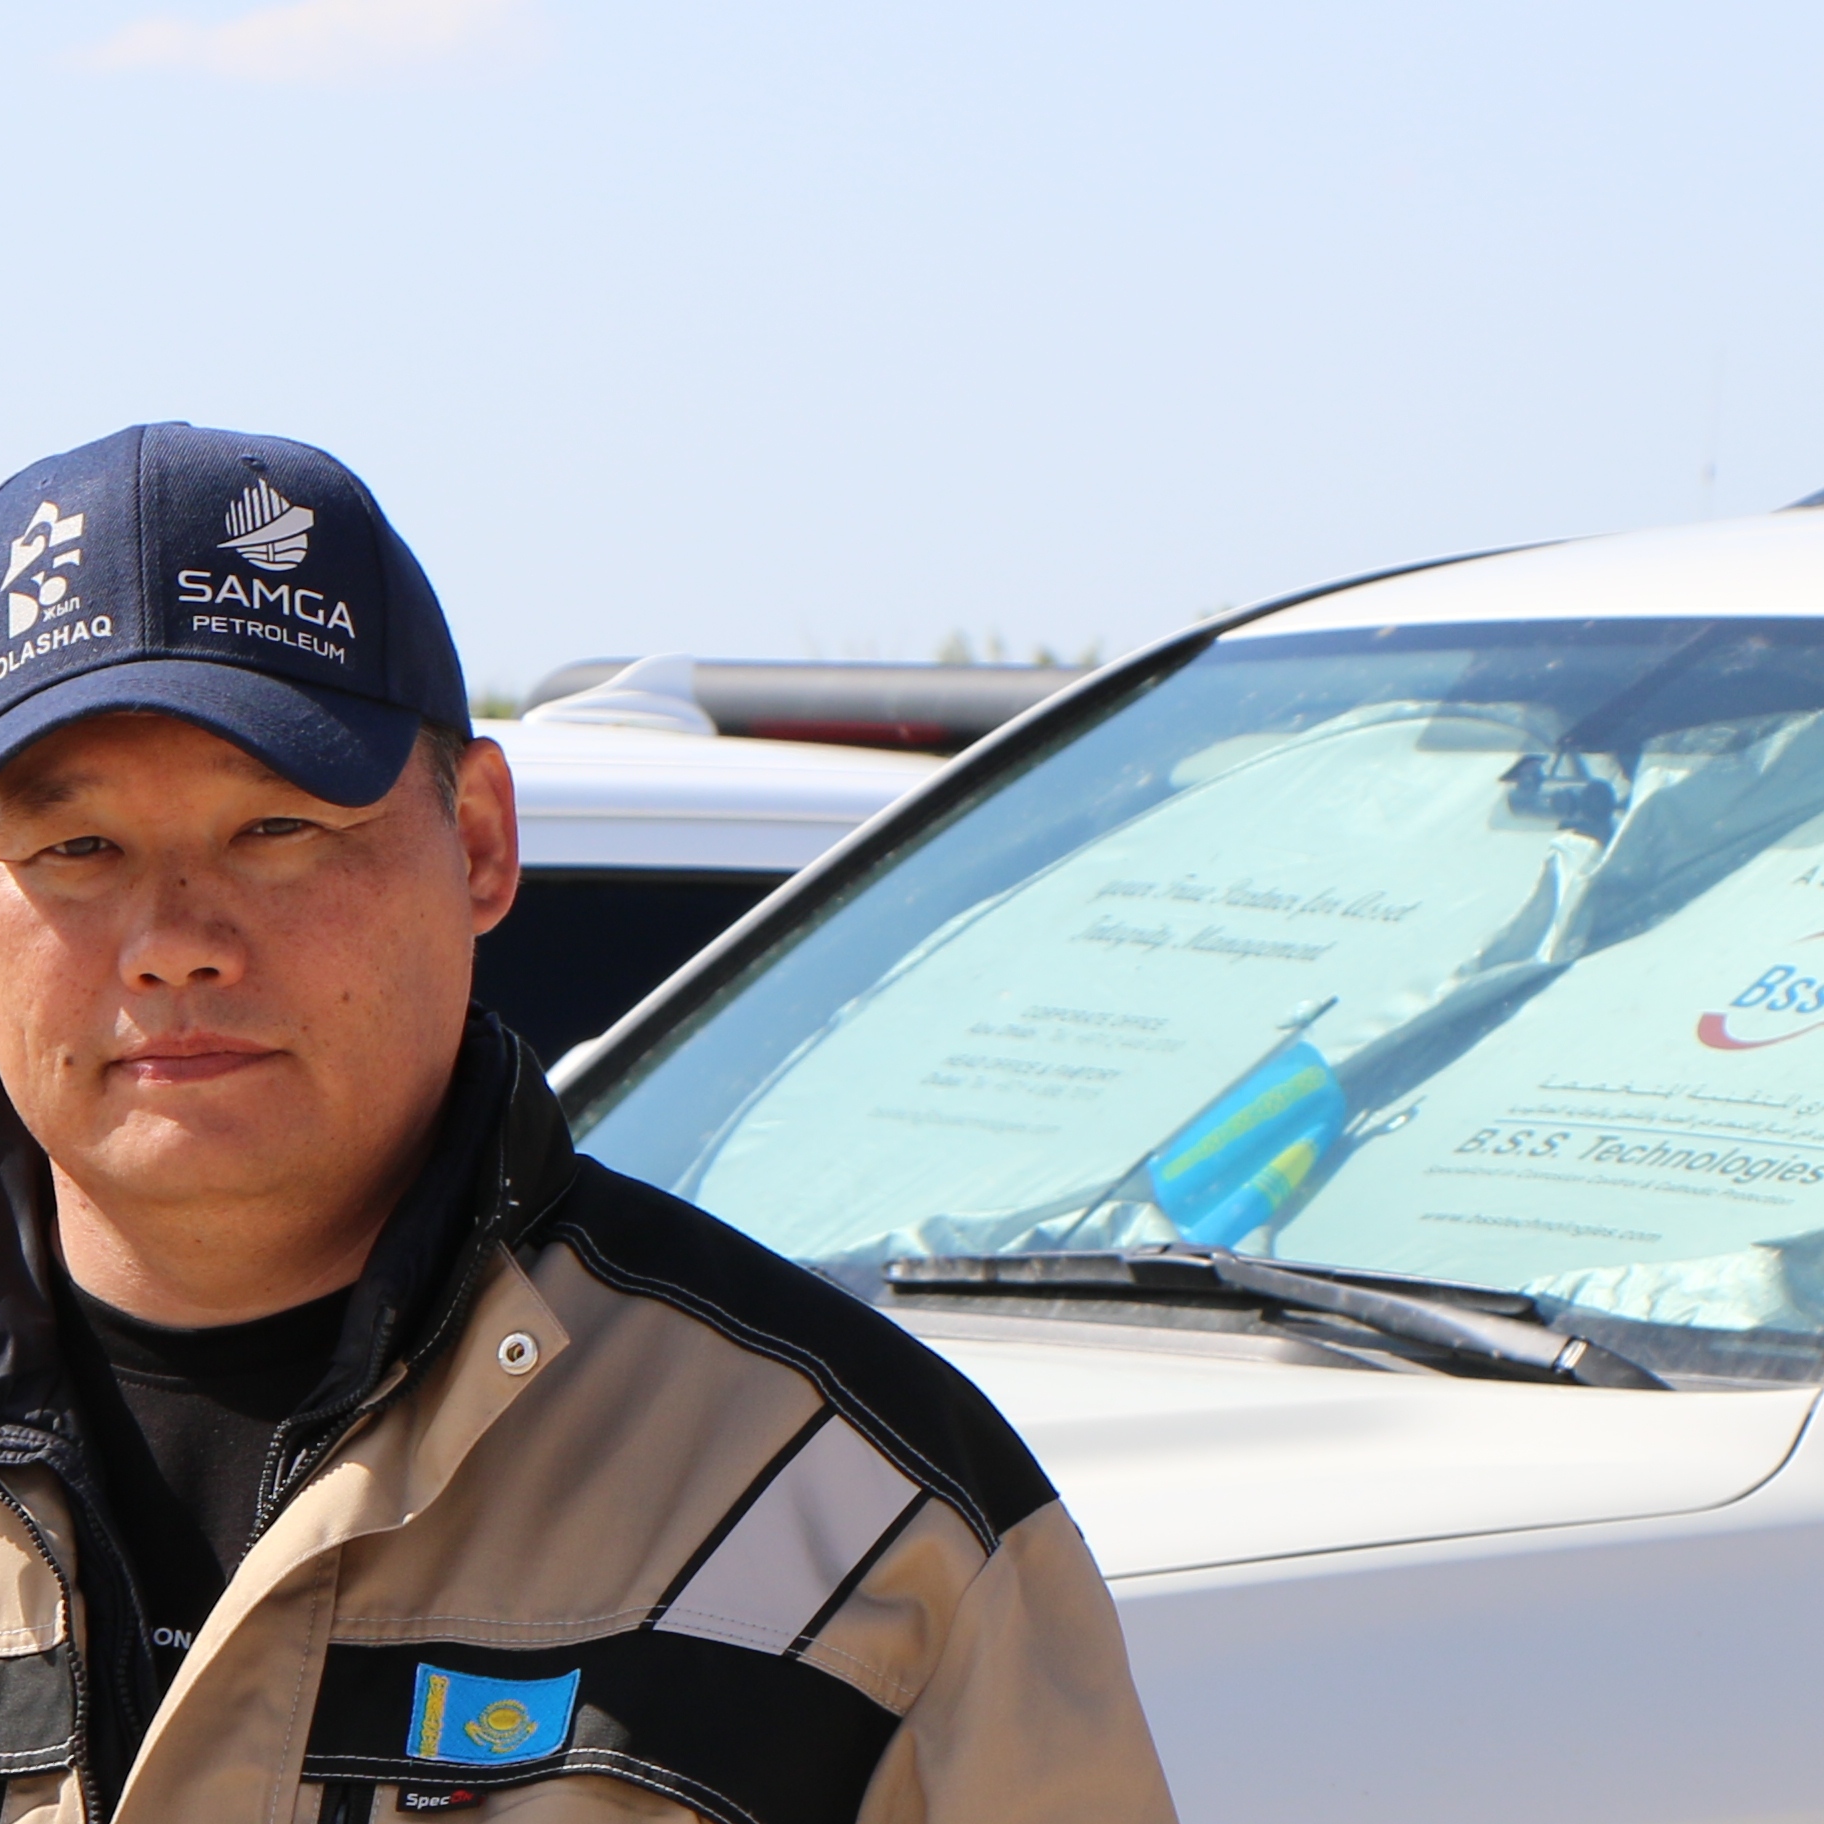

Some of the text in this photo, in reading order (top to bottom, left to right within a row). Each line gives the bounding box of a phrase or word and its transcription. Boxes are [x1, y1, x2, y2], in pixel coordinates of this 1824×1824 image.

[177, 570, 356, 639] SAMGA
[192, 614, 345, 665] PETROLEUM
[1452, 1128, 1572, 1159] B.S.S.
